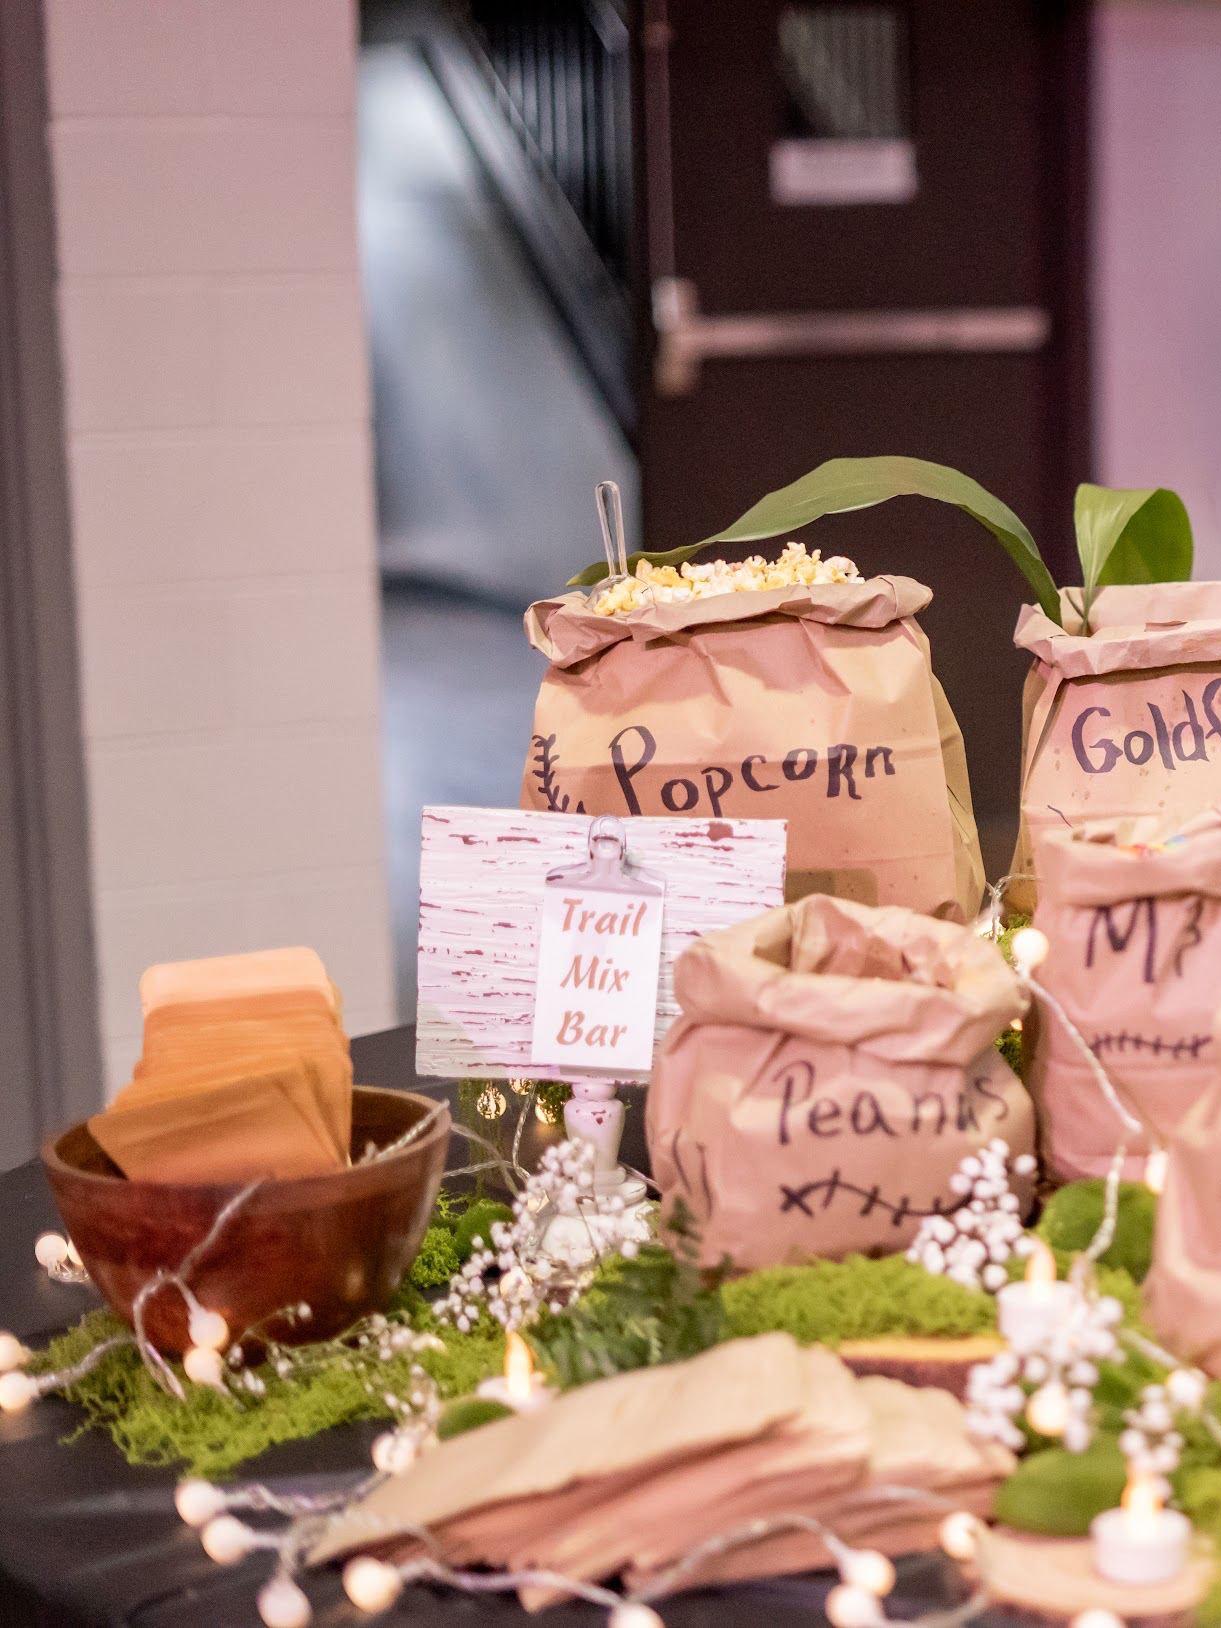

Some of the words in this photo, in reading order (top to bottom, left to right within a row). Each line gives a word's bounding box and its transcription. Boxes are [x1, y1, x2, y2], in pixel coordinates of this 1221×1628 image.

[607, 725, 896, 817] Popcorn
[561, 897, 648, 937] Trail
[559, 954, 630, 994] Mix
[555, 1010, 628, 1048] Bar
